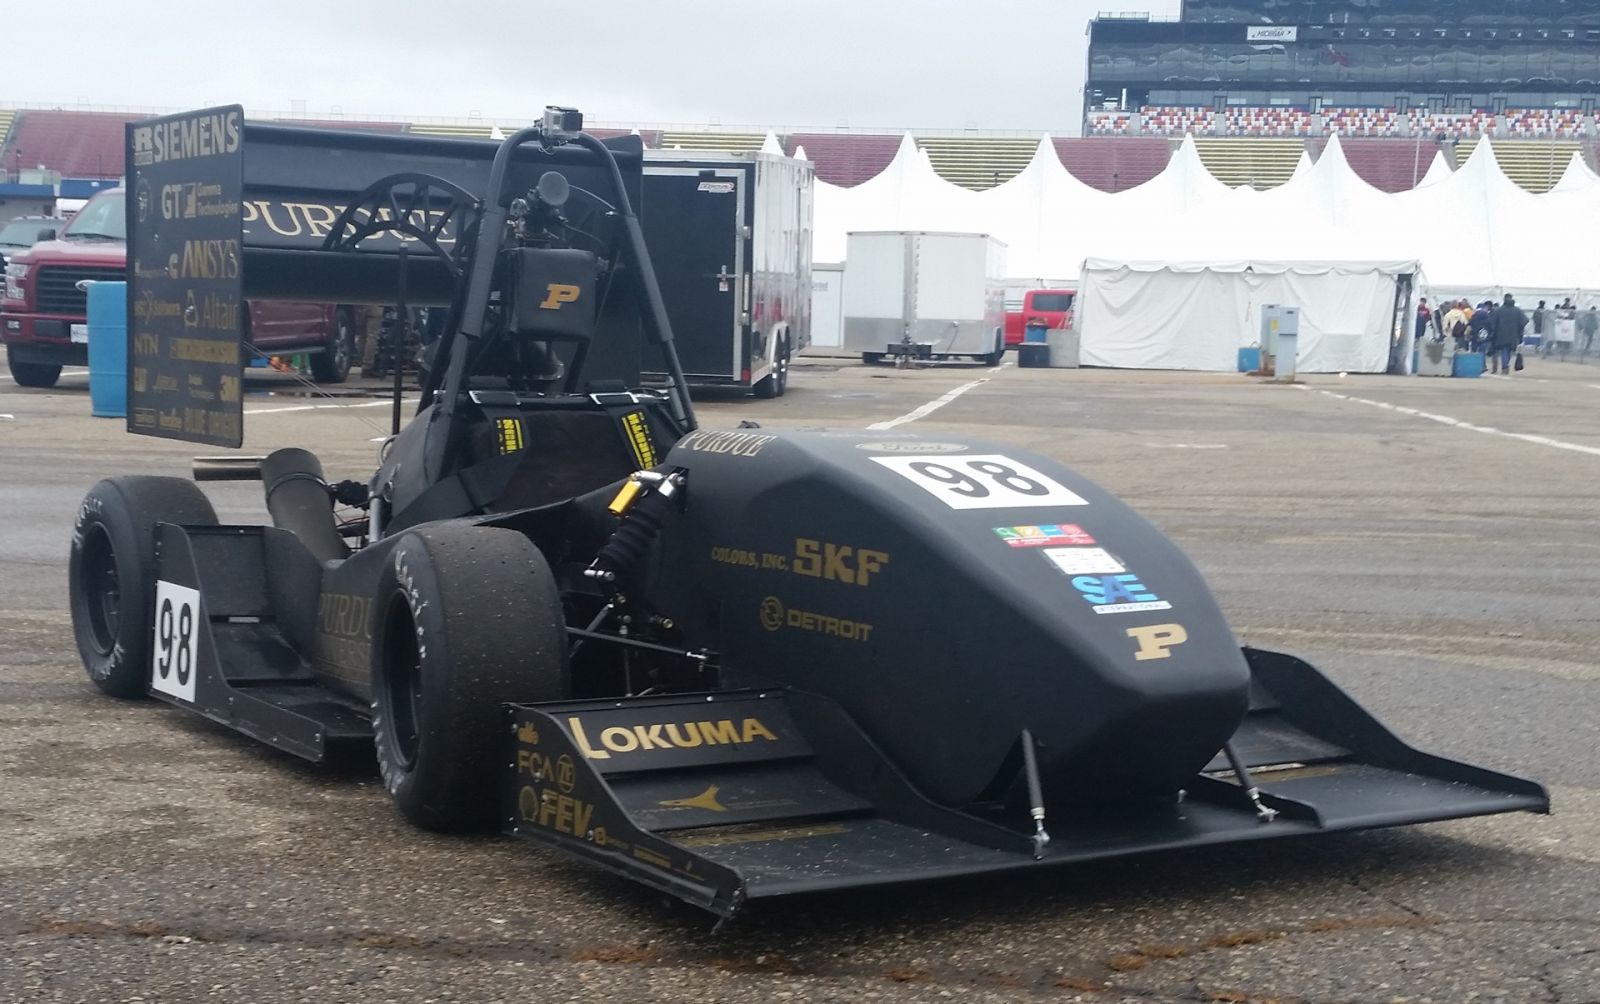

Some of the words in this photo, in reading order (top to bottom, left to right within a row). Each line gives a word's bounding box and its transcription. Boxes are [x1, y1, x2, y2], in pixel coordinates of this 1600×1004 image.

[153, 112, 239, 162] SIEMENS
[162, 184, 182, 219] GT
[182, 239, 238, 278] ANSYS
[203, 291, 238, 329] Altair
[539, 284, 581, 309] P
[220, 376, 239, 402] 3M
[678, 431, 777, 457] PURDUE
[909, 461, 1050, 498] 98
[711, 547, 758, 569] COLORS,
[762, 553, 789, 571] INC.
[793, 537, 889, 586] SKF
[1071, 574, 1159, 604] SAE
[159, 598, 191, 686] 98
[787, 609, 873, 641] DETROIT
[1126, 623, 1188, 661] P
[538, 788, 594, 839] FEV
